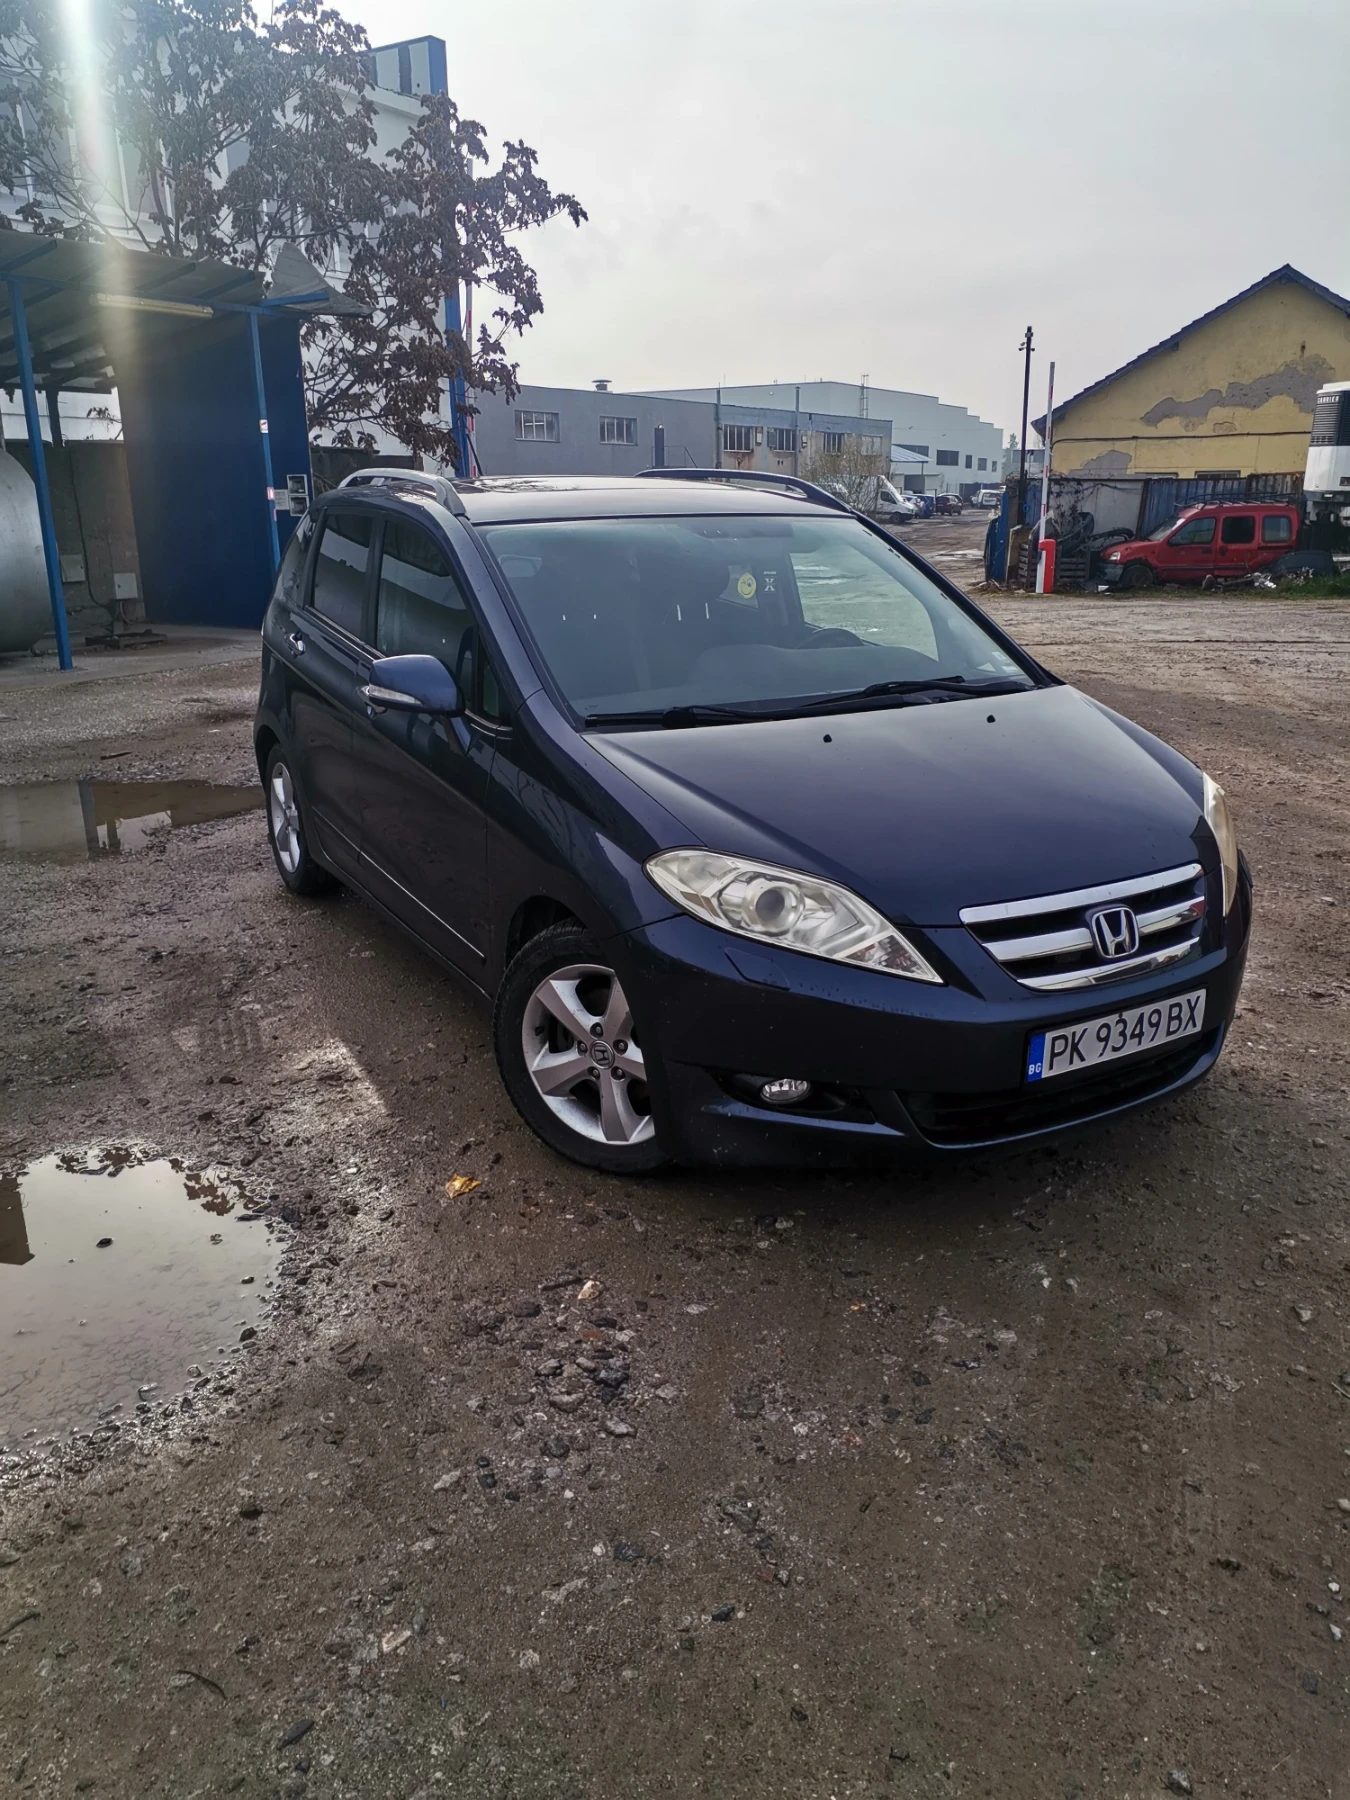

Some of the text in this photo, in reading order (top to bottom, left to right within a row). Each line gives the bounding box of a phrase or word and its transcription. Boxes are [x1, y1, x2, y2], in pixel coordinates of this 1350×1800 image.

[1048, 995, 1202, 1071] PK 9349 BX
[1028, 1063, 1042, 1075] BG
